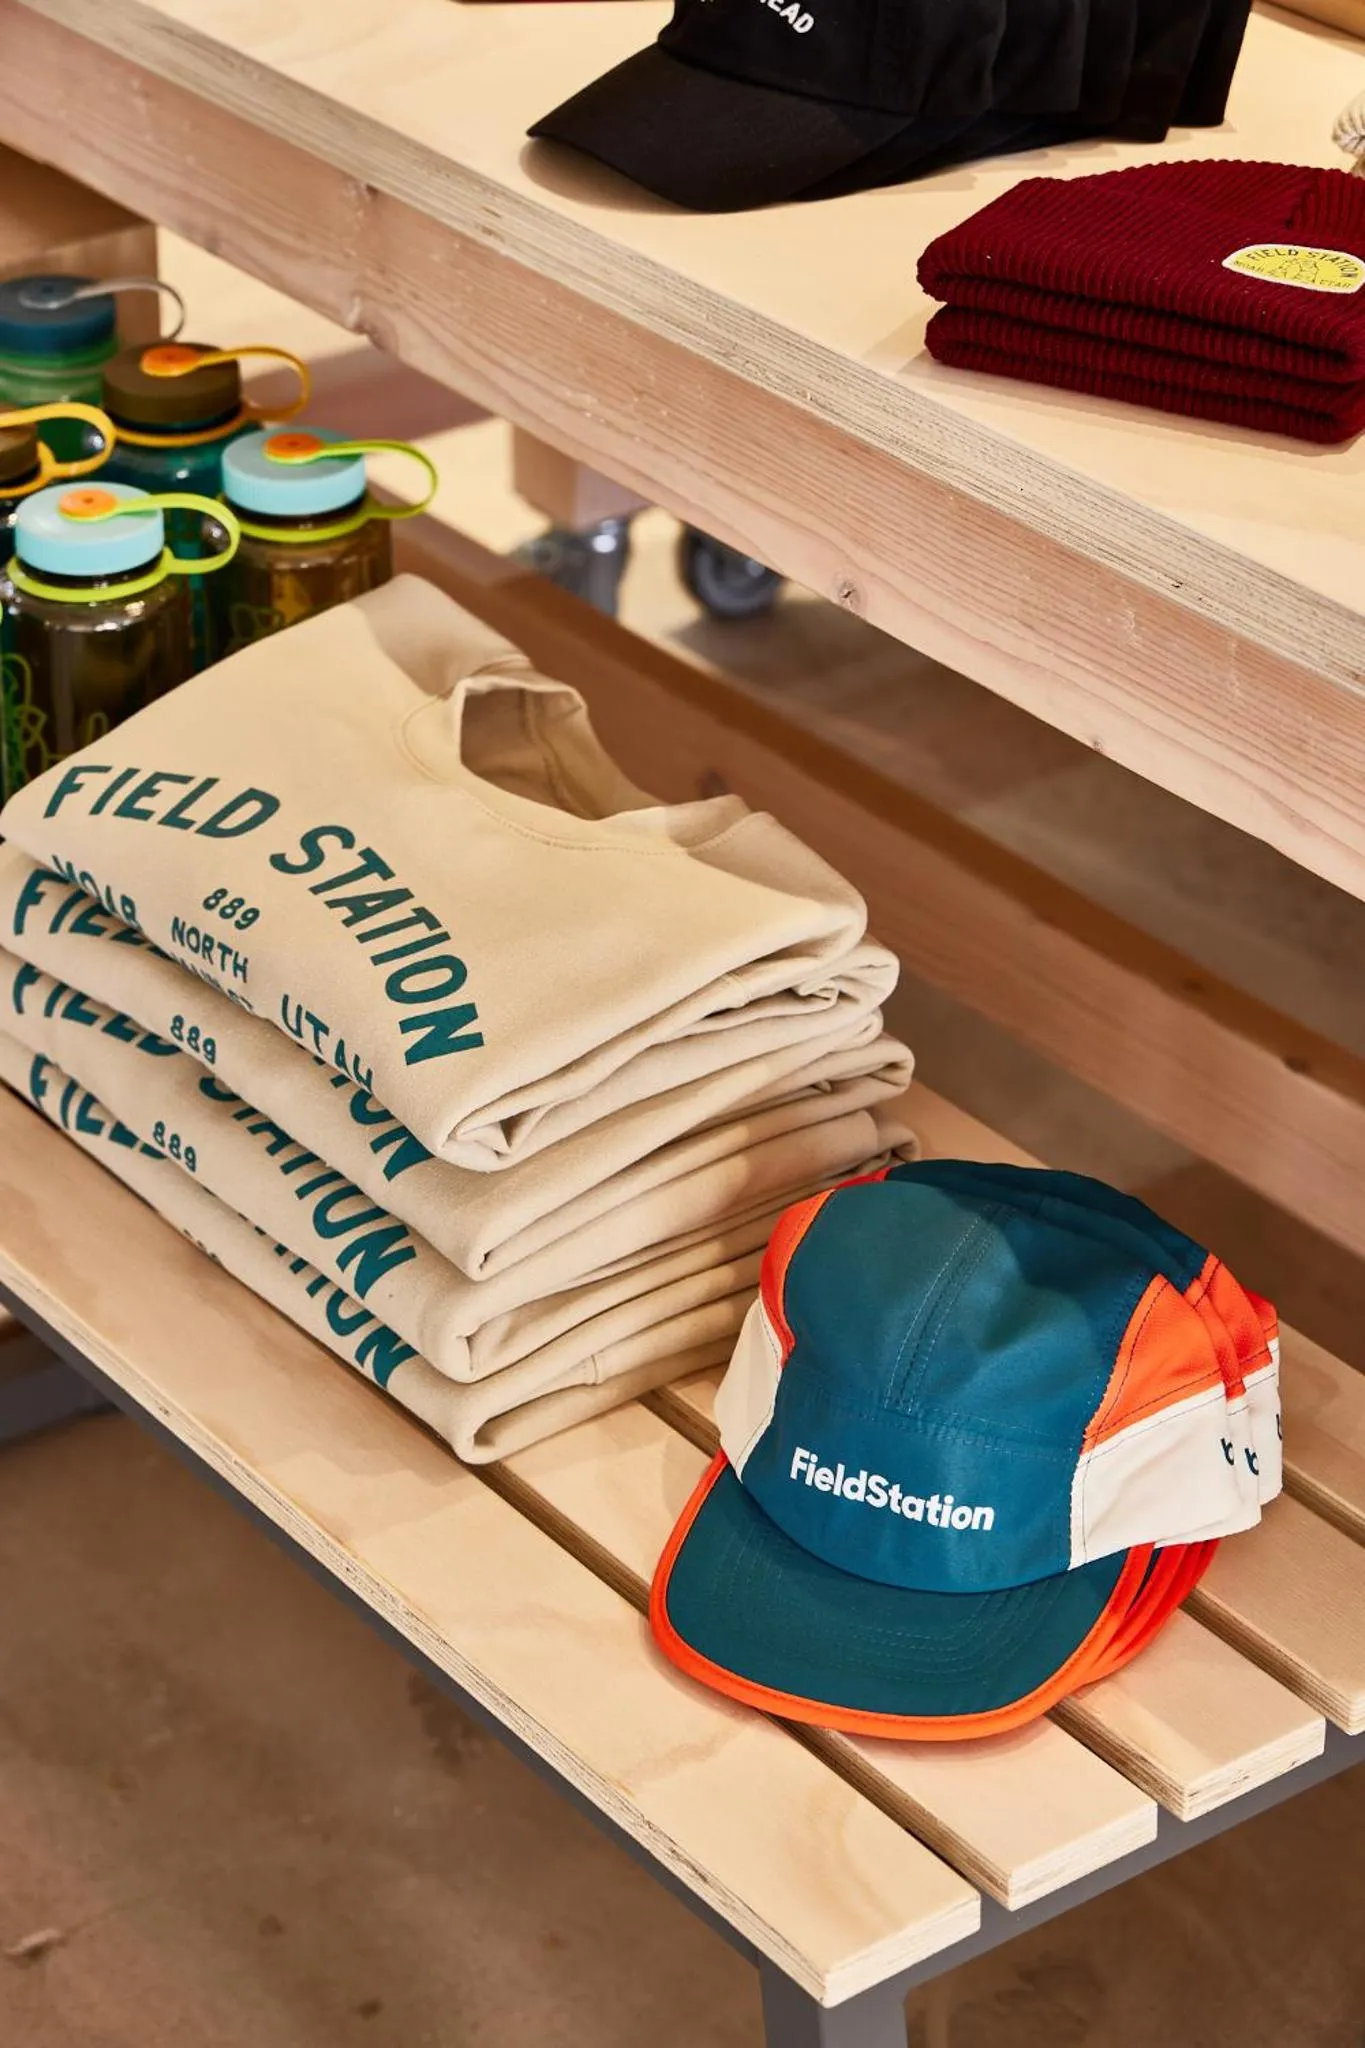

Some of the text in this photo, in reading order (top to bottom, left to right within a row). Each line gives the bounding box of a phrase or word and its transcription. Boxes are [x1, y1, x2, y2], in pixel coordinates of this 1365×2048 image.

[760, 0, 815, 34] EAD
[1246, 248, 1299, 261] FIELD
[43, 765, 486, 1067] FIELD STATION
[202, 887, 261, 931] 889
[170, 916, 249, 984] NORTH
[170, 1014, 216, 1065] 889
[152, 1120, 197, 1173] 889
[788, 1446, 996, 1531] FieldStation
